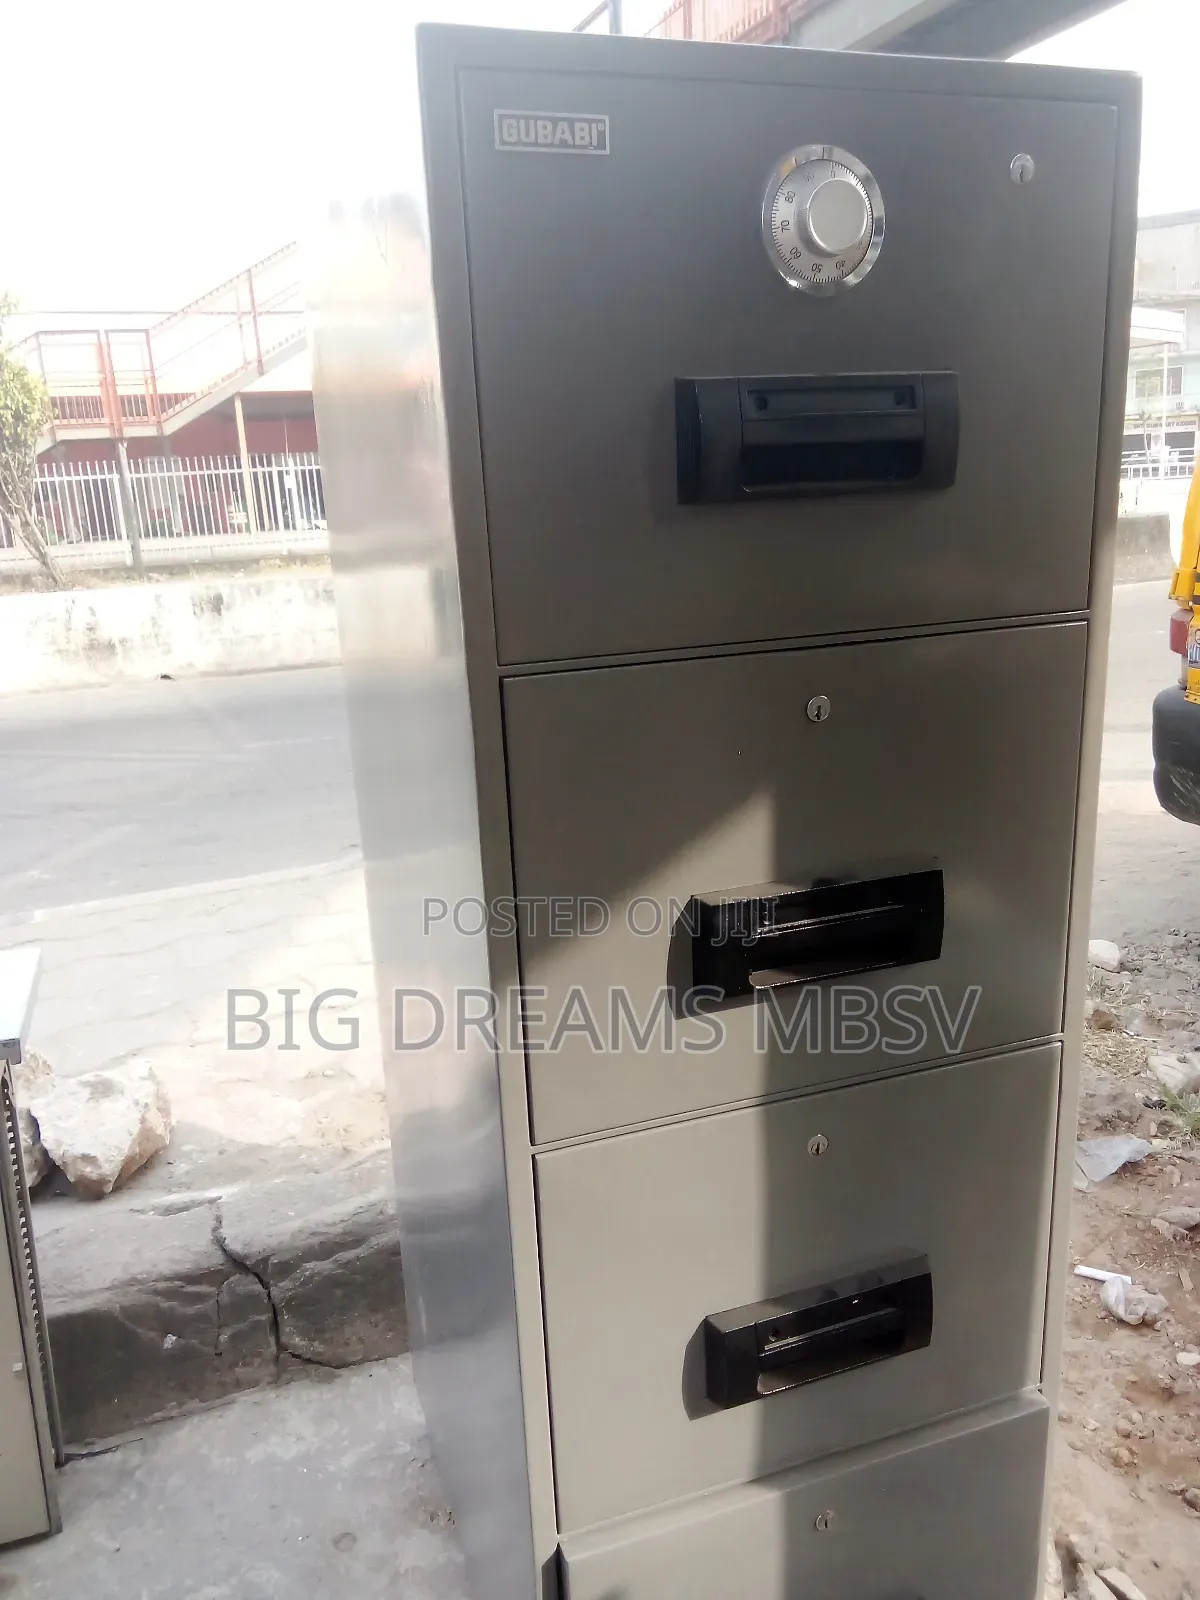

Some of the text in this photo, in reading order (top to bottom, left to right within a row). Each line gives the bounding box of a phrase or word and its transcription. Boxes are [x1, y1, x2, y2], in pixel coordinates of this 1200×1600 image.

[784, 190, 796, 203] 80
[780, 220, 790, 233] 70
[789, 246, 802, 260] 60
[811, 261, 824, 274] 50
